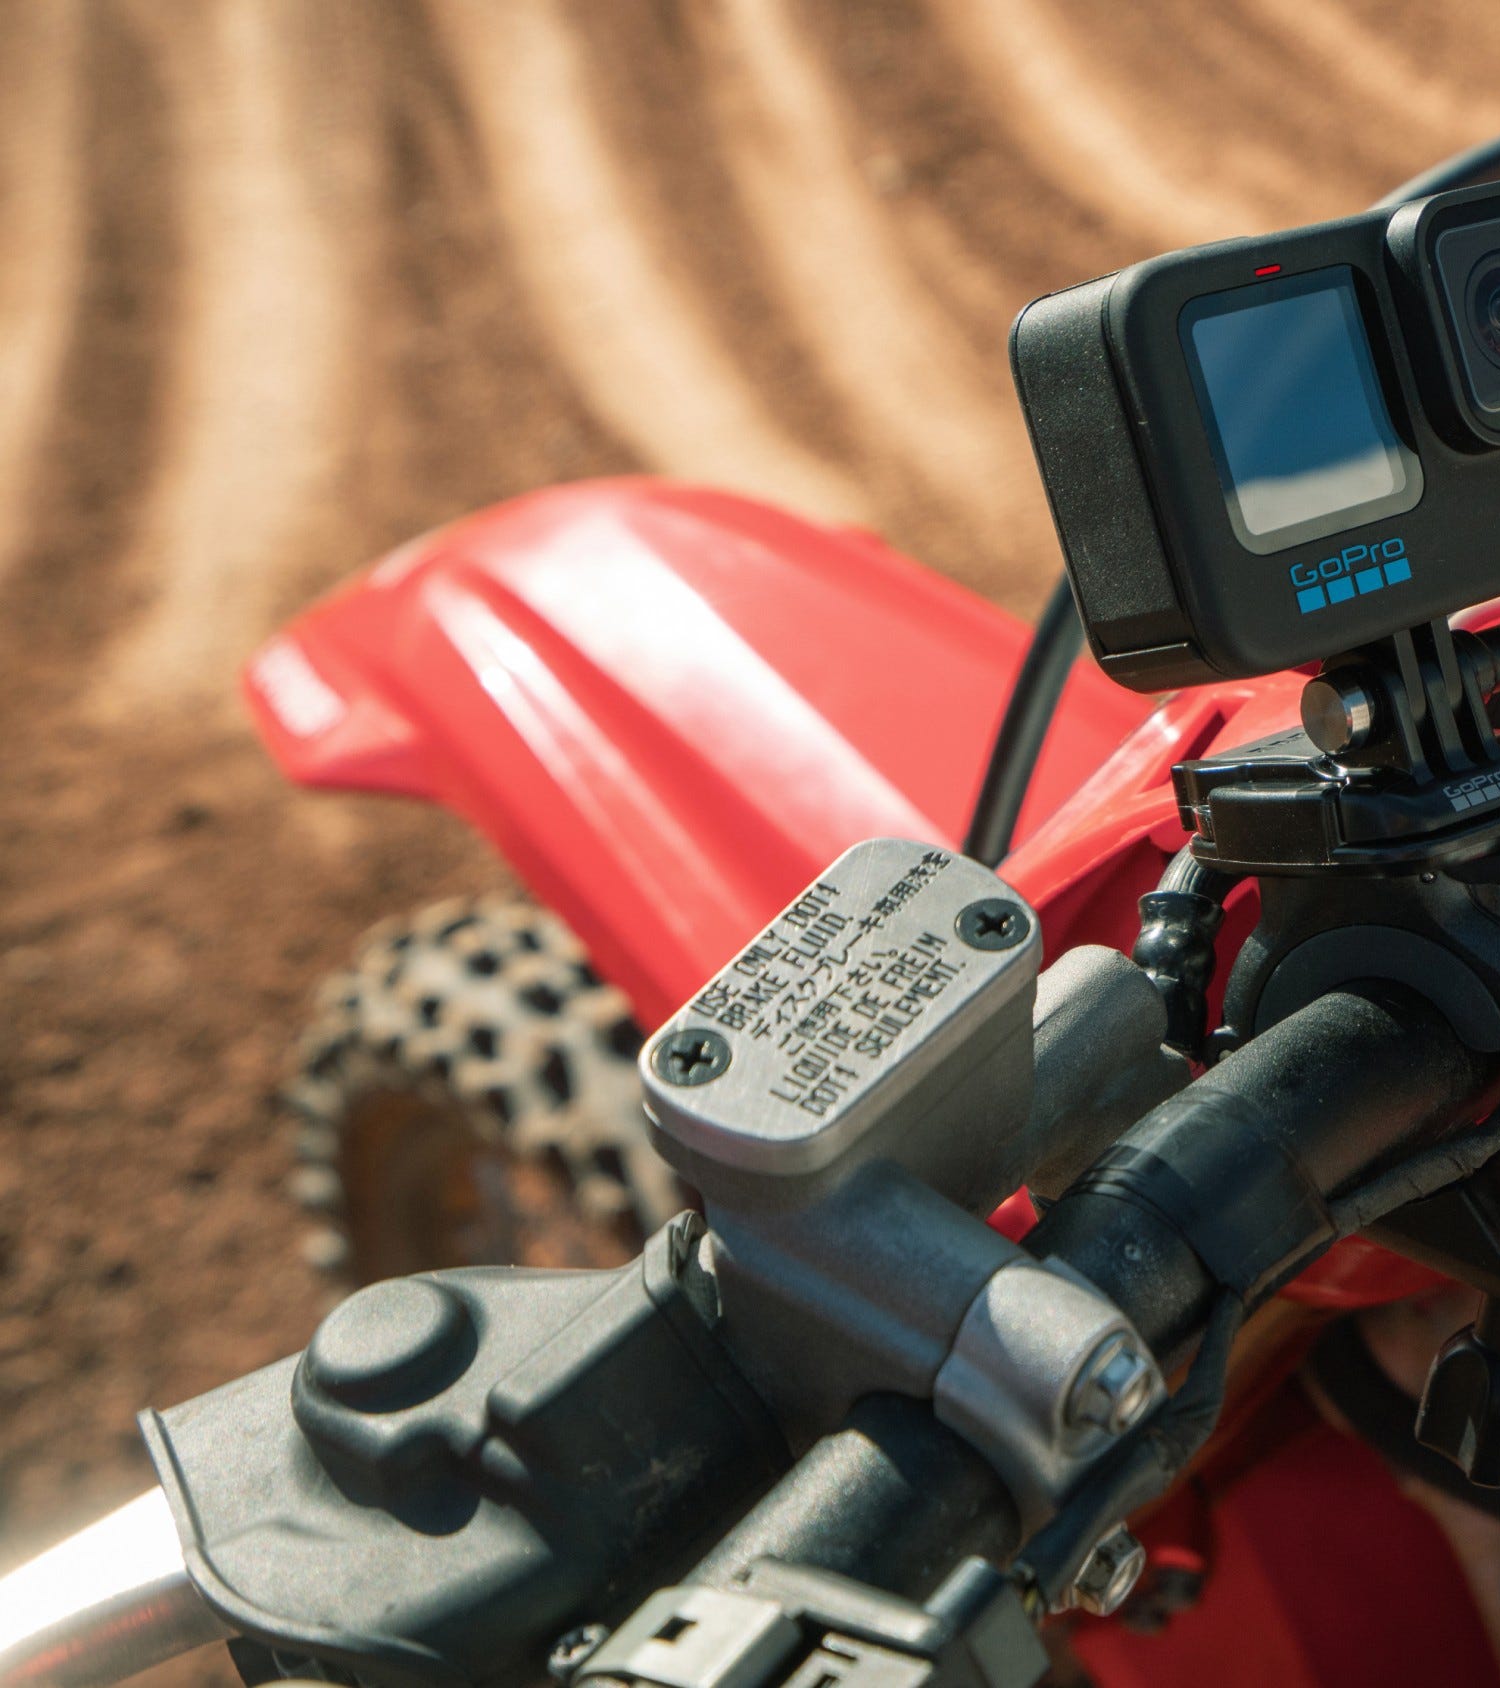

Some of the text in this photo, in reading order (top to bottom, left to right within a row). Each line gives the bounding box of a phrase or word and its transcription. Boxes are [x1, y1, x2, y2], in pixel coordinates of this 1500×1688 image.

[1290, 536, 1406, 587] GoPro
[690, 882, 841, 1019] USE ONLY DOT4
[716, 914, 855, 1031] BRAKE FLUID.
[770, 931, 949, 1103] LIQUIDE DE FREIN
[800, 959, 966, 1117] DOT4 SEULEMENT.
